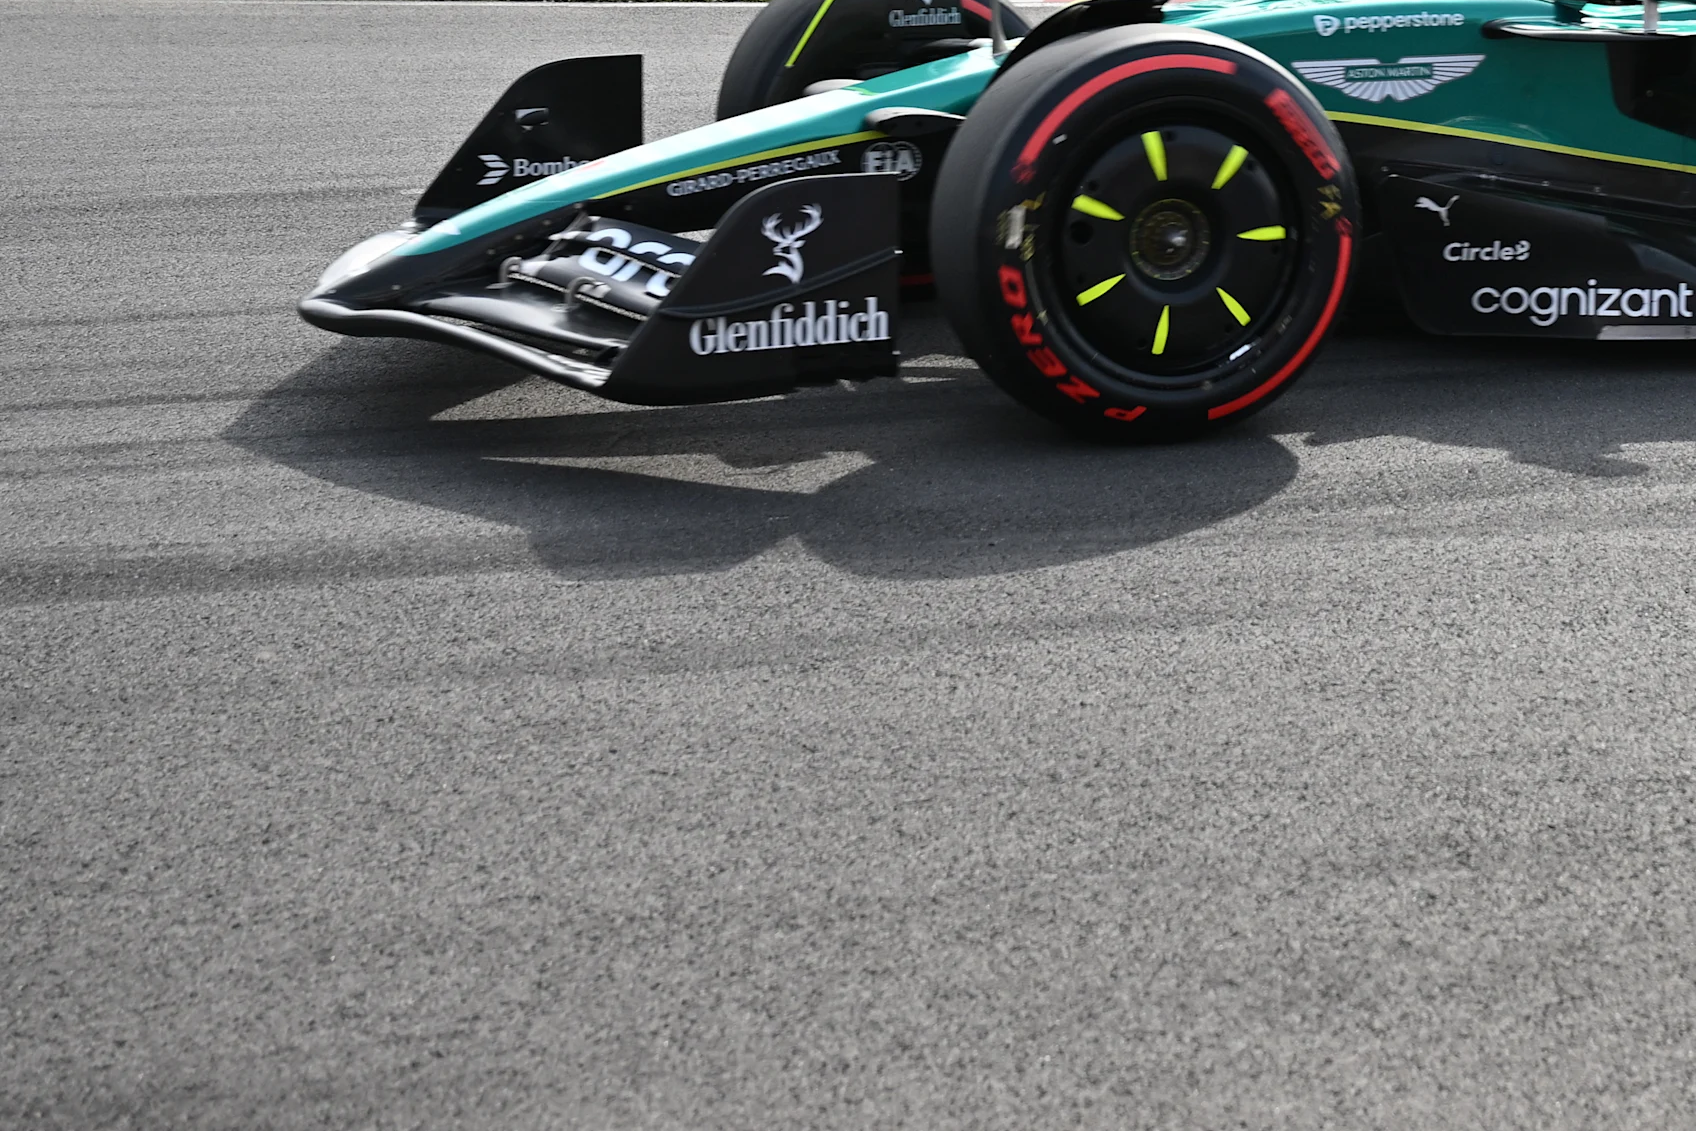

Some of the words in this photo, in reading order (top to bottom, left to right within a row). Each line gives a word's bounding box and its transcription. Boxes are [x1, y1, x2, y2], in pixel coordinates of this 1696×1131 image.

[1344, 11, 1464, 34] pepperstone
[1348, 68, 1385, 79] ASTON
[1386, 66, 1431, 77] MARTIN
[513, 156, 591, 177] Bomb
[666, 150, 841, 196] GIRARD-PERREGAUX
[1471, 279, 1693, 326] cognizant
[690, 297, 890, 356] Glenfiddich
